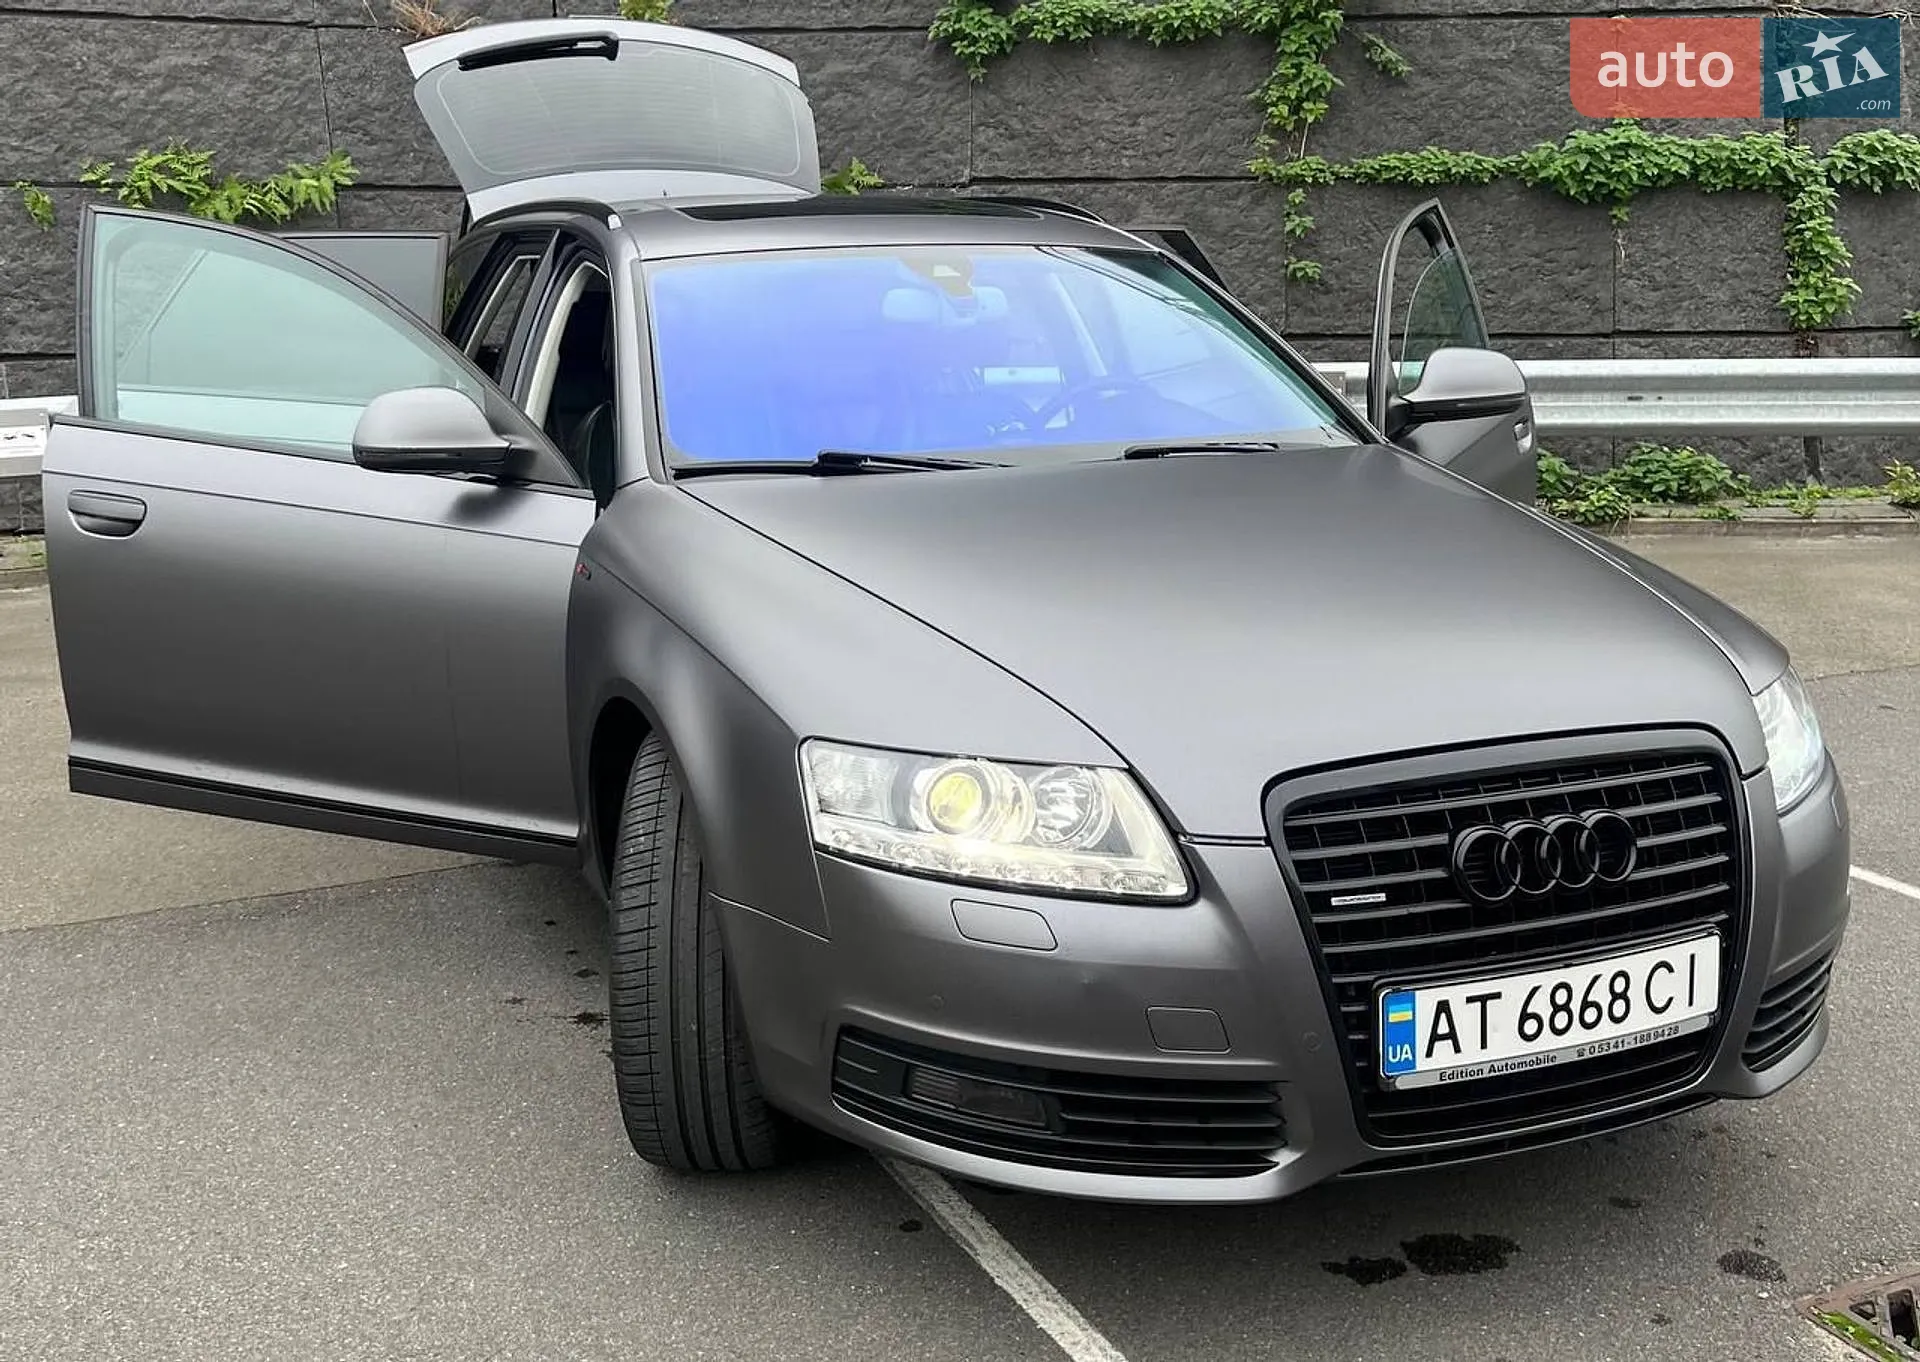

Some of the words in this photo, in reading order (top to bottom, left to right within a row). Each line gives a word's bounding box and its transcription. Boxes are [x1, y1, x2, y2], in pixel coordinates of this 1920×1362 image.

[1425, 991, 1502, 1058] AT
[1517, 970, 1632, 1042] 6868
[1645, 953, 1697, 1015] CI
[1388, 1043, 1413, 1062] UA
[1439, 1068, 1485, 1082] Edition
[1488, 1054, 1558, 1074] Automobile
